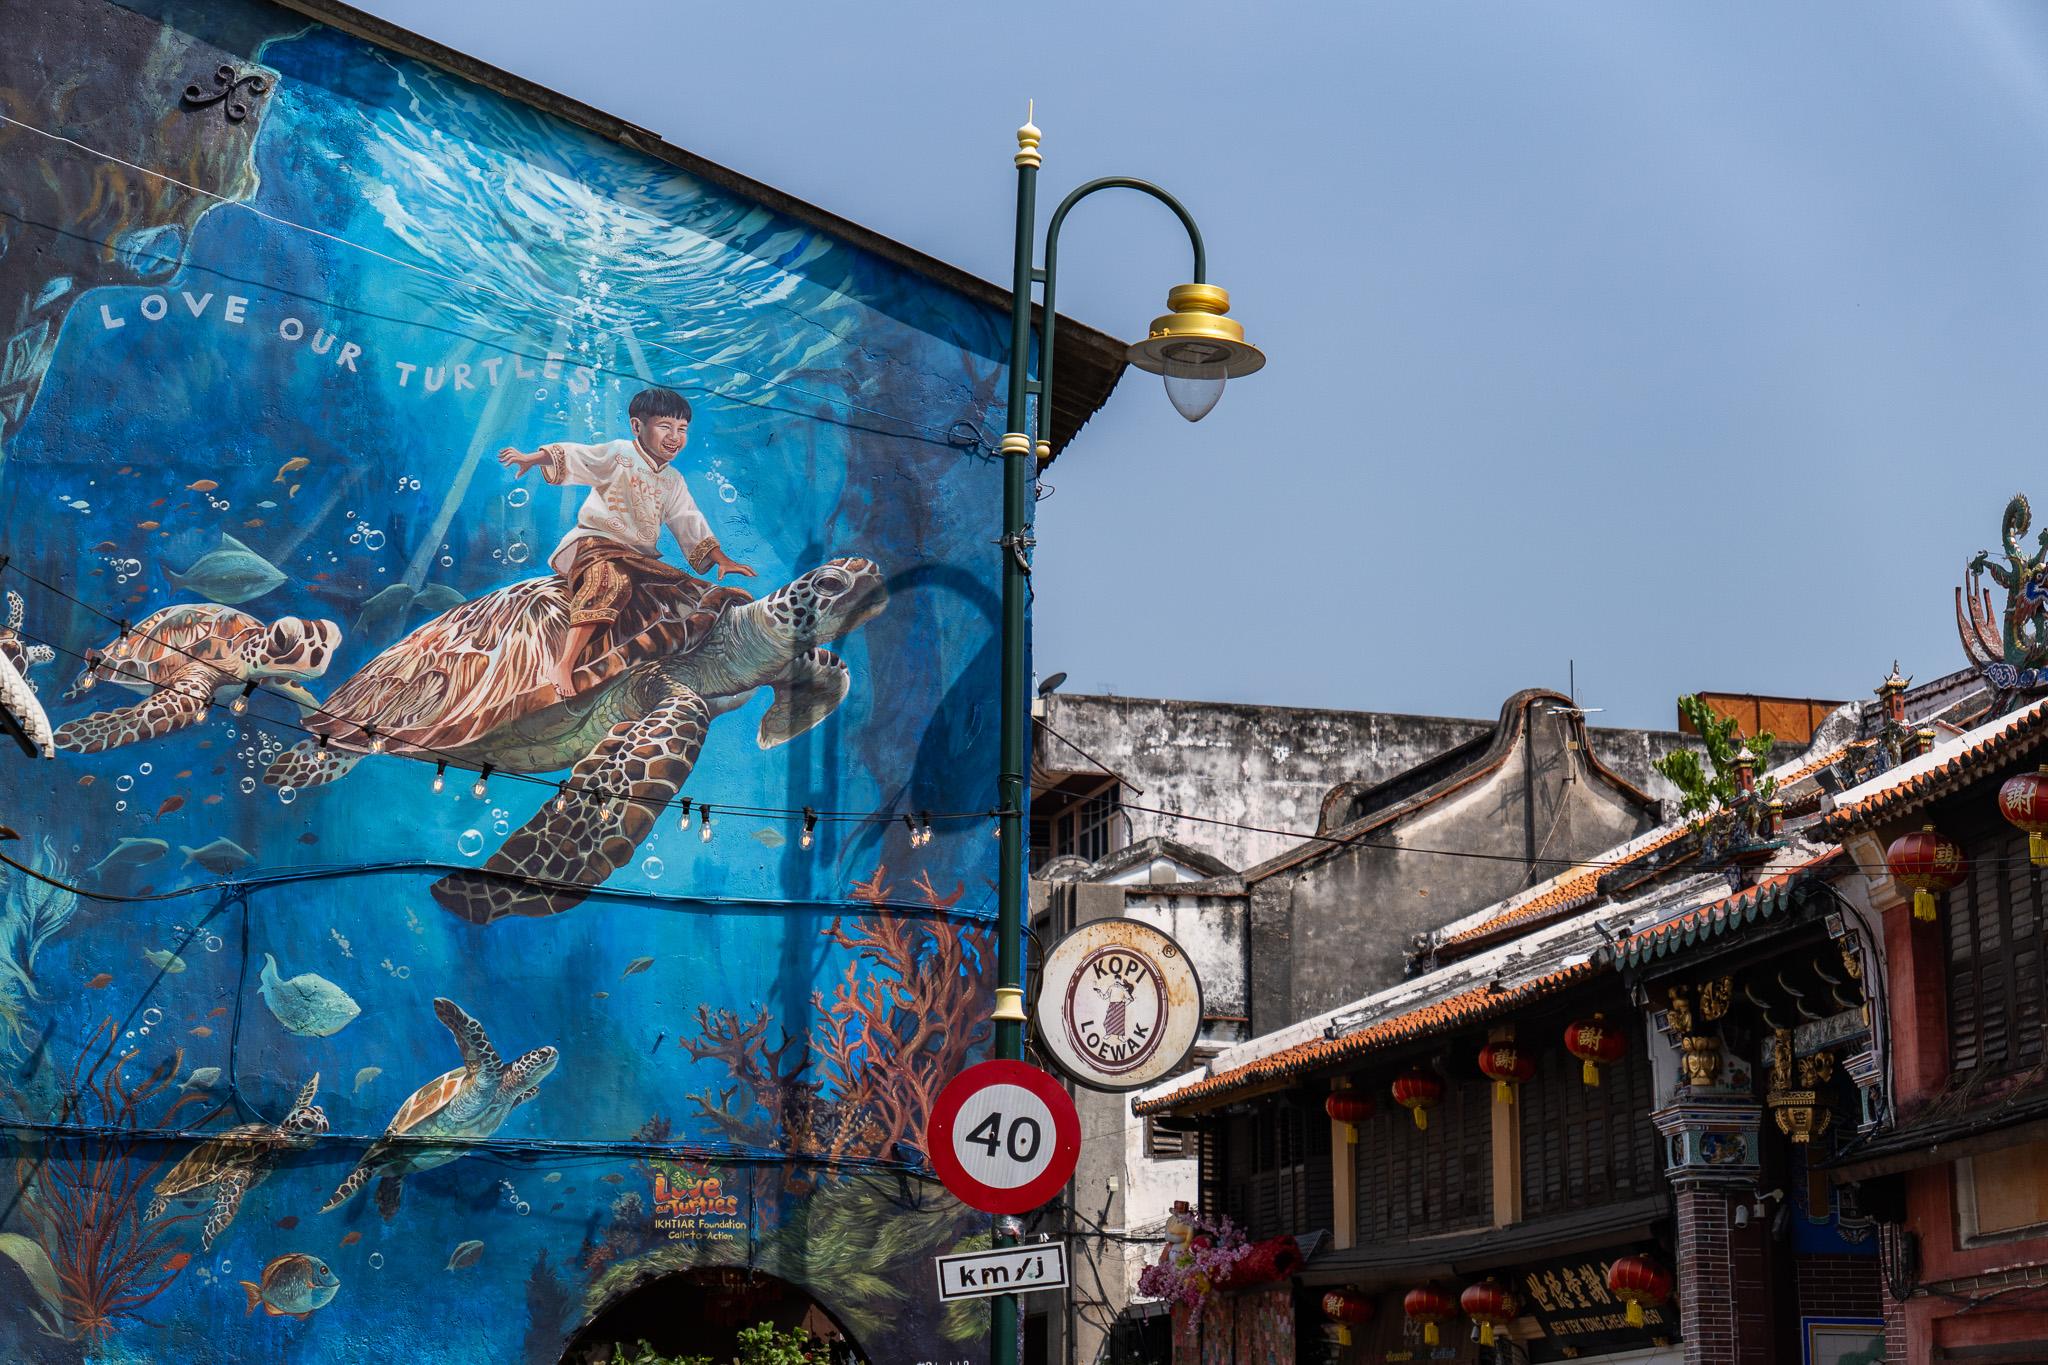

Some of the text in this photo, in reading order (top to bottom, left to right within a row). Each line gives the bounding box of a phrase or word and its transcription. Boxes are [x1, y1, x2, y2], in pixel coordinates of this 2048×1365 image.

[100, 292, 596, 394] LOVE OUR TURTLES
[2006, 781, 2036, 815] 謝
[1935, 843, 1963, 875] 謝
[1092, 956, 1147, 984] KOPI
[1080, 1019, 1149, 1062] LOEWAK
[1578, 1026, 1604, 1051] 謝
[1493, 1048, 1518, 1072] 謝
[965, 1111, 1042, 1164] 40
[655, 1219, 747, 1230] IKHTIAR Foundation
[668, 1231, 734, 1241] Call-to-Action
[959, 1256, 1045, 1289] km/j
[1549, 1320, 1568, 1336] SEH
[1564, 1318, 1585, 1334] TEK
[1582, 1315, 1605, 1333] TONG
